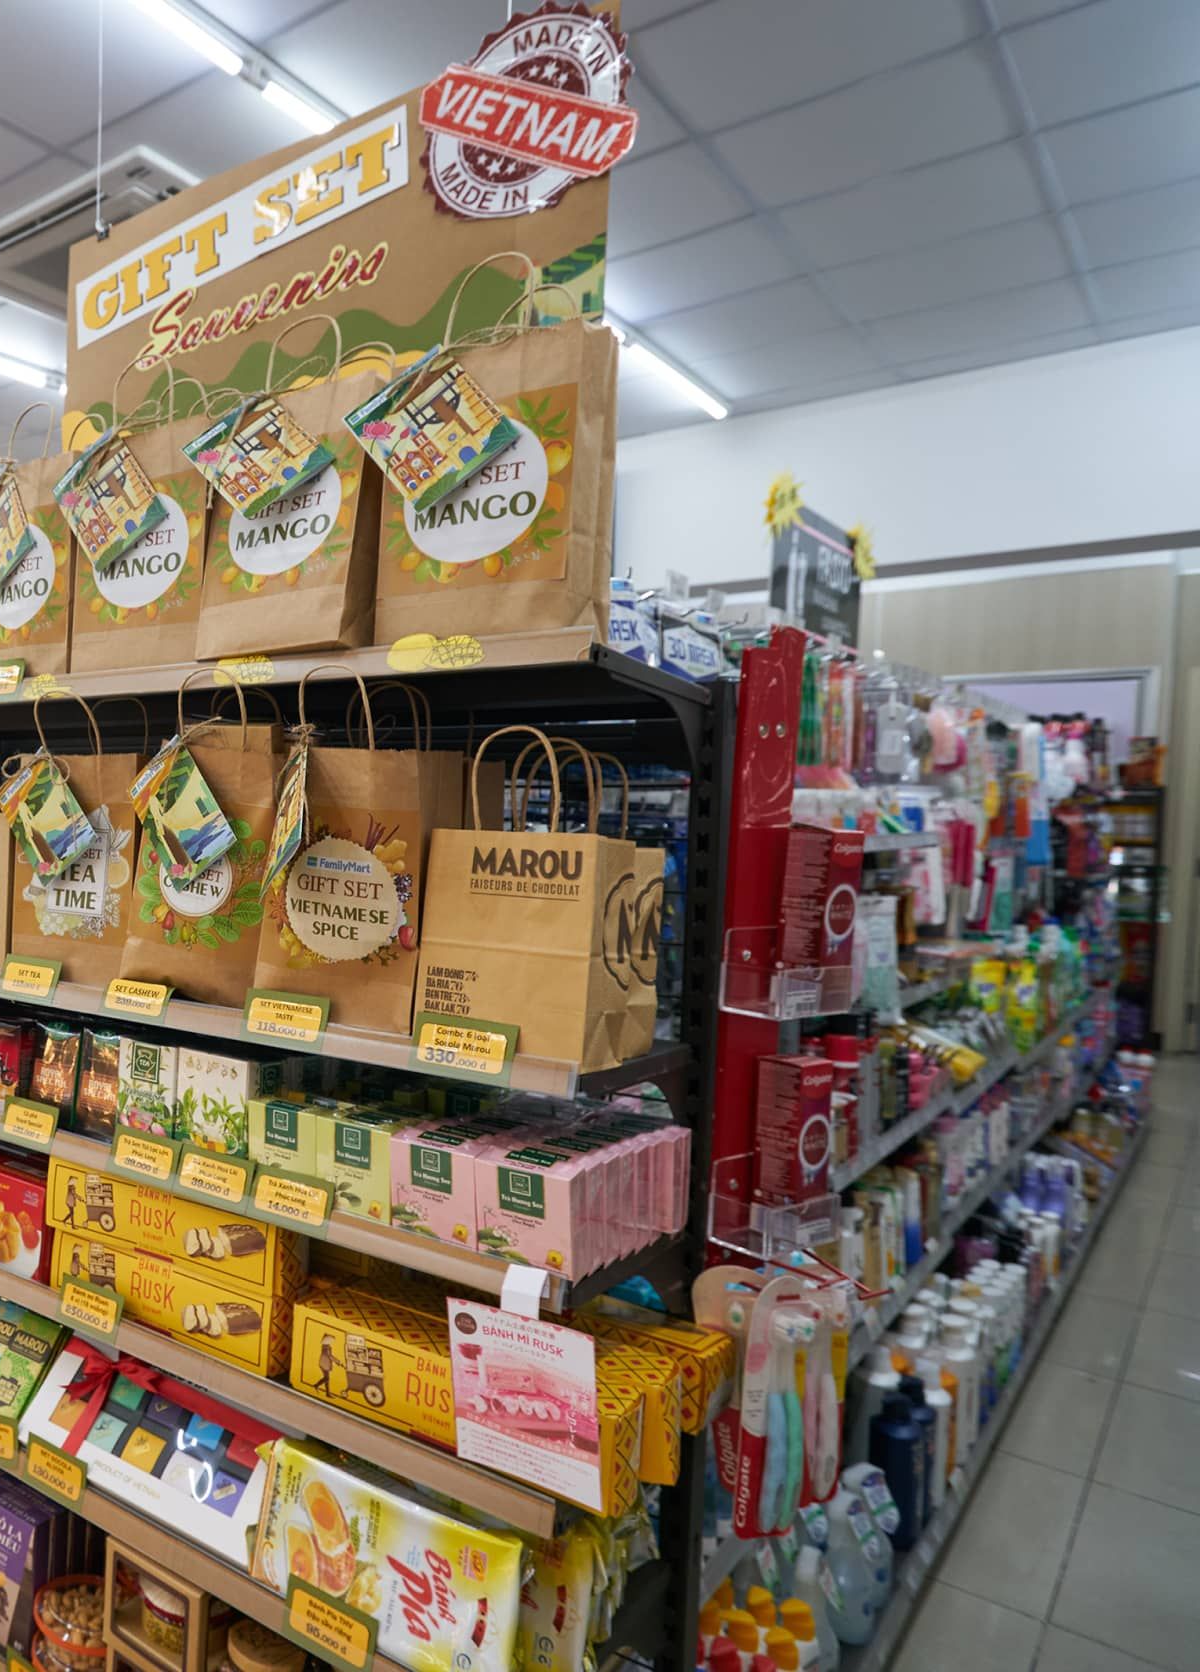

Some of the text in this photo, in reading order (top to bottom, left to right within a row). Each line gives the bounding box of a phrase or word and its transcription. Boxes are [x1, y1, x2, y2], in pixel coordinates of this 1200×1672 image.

[512, 24, 608, 73] MADE IN
[436, 80, 620, 163] VIETNAM
[441, 162, 528, 207] MADE IN
[84, 121, 402, 331] GIFT SET
[136, 242, 388, 372] Souvenirs
[480, 461, 526, 485] SET
[291, 490, 326, 511] SET
[414, 491, 537, 532] MANGO
[145, 529, 175, 547] SET
[236, 514, 330, 551] MANGO
[20, 556, 43, 573] SET
[100, 552, 181, 582] MANGO
[668, 636, 717, 668] 3D MASK
[81, 849, 103, 860] SET
[319, 857, 372, 874] FamilyMart
[472, 847, 583, 881] MAROU
[53, 888, 97, 910] TIME
[297, 874, 383, 900] GIFT SET
[470, 878, 580, 897] FAISEURS DE CHOCOLAT
[290, 898, 389, 925] VIETNAMESE
[312, 921, 359, 940] SPICE
[129, 987, 160, 998] CASHEW
[130, 1200, 176, 1237] RUSK
[130, 1272, 176, 1312] RUSK
[15, 1332, 47, 1355] MAROU
[532, 1338, 564, 1358] RUSK
[416, 1356, 447, 1378] BÁNH
[405, 1372, 451, 1414] RUS
[719, 1421, 737, 1486] Colgate
[735, 1454, 752, 1529] Colgate
[8, 1522, 23, 1543] LA
[386, 1554, 440, 1642] Pía
[423, 1548, 457, 1625] Bánh
